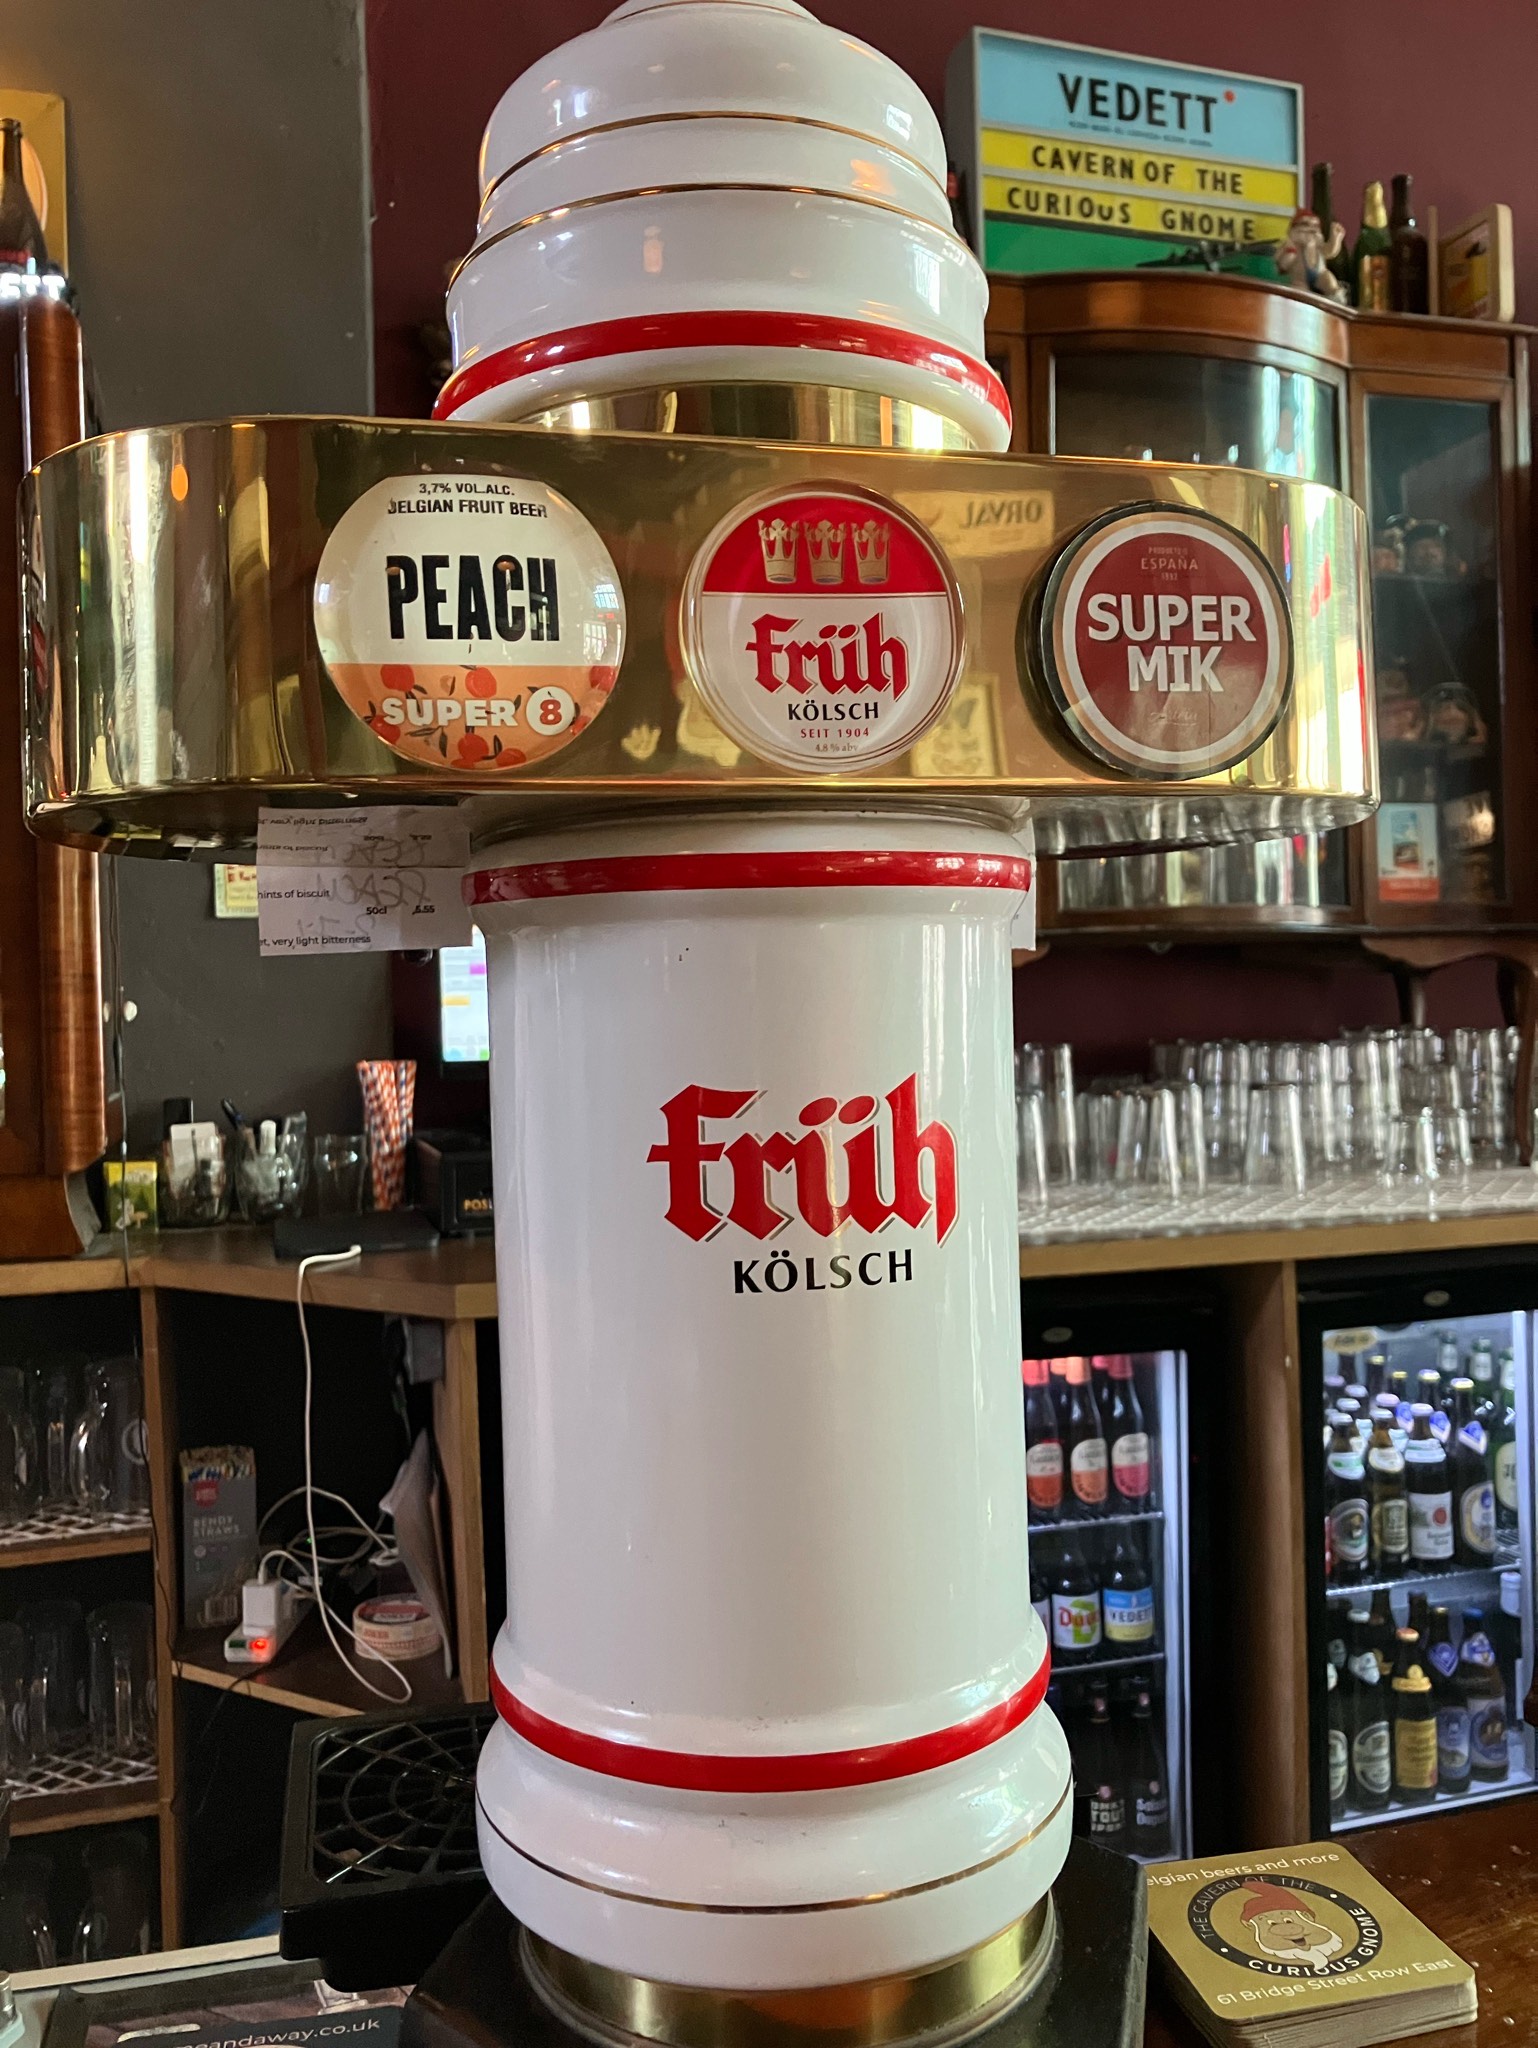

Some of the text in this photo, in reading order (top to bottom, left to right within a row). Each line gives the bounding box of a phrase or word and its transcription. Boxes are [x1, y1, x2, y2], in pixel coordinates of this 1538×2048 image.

[1058, 72, 1219, 135] VEDETT
[1032, 145, 1243, 195] CAVERN OF THE
[1161, 208, 1256, 241] GNOME
[419, 482, 451, 494] 3,7%
[459, 499, 505, 514] FRUIT
[510, 501, 548, 518] BEER
[1141, 555, 1199, 570] ESPAÑA
[386, 555, 559, 642] PEACH
[1087, 593, 1256, 642] SUPER
[1127, 646, 1224, 692] MIK
[381, 697, 563, 727] SUPER 8
[788, 699, 880, 721] KÖLSCH
[800, 727, 870, 739] SEIT 1904
[284, 890, 295, 899] of
[296, 889, 331, 898] biscuit
[366, 905, 388, 916] 50cl
[272, 938, 295, 948] very
[296, 937, 320, 947] light
[321, 935, 372, 945] bitterness
[734, 1249, 913, 1294] KÖLSCH
[1199, 1863, 1252, 1879] beers
[1255, 1858, 1289, 1872] and
[1293, 1853, 1340, 1868] more
[1192, 1878, 1241, 1915] CAVERN
[1281, 1877, 1318, 1893] THE
[1193, 1916, 1216, 1941] THE
[1248, 1907, 1380, 1977] CURIOUS GNOME
[1216, 1957, 1456, 2006] 61 Bridge Street Row East
